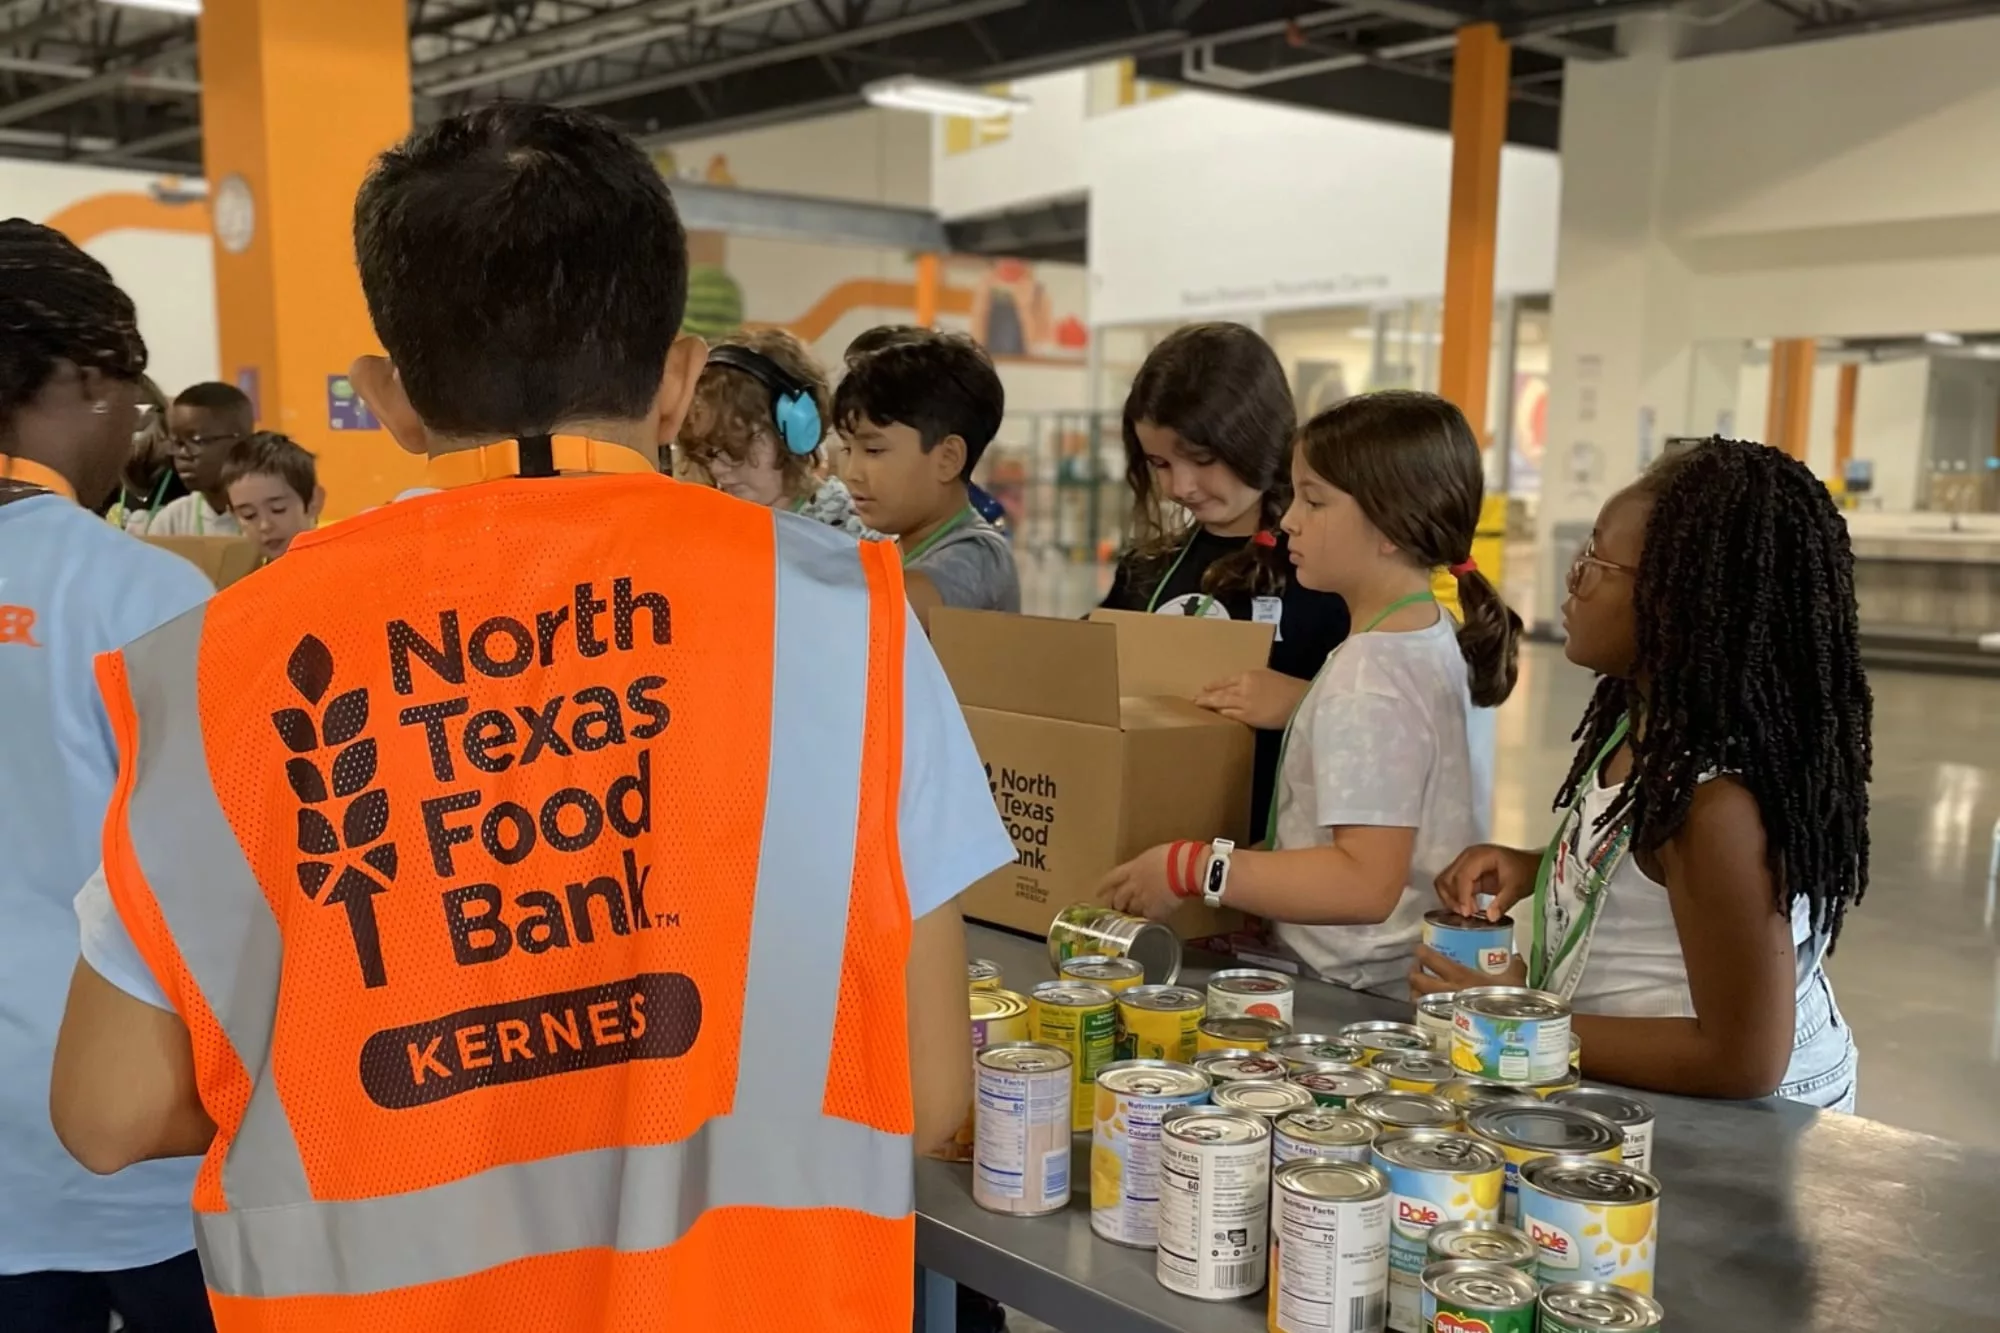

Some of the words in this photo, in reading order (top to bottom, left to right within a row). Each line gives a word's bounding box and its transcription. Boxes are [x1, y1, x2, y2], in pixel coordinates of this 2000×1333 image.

[386, 577, 672, 695] North
[399, 675, 671, 782] Texas
[1001, 767, 1057, 799] North
[421, 749, 650, 877] Food
[1001, 792, 1054, 823] Texas
[1001, 816, 1049, 846] ood
[1012, 847, 1046, 871] ank
[442, 848, 652, 966] Bank
[1128, 1101, 1164, 1110] Nutrition
[1187, 1180, 1199, 1191] 60
[1313, 1206, 1335, 1215] Facts
[1400, 1201, 1438, 1223] Dole
[1323, 1233, 1335, 1242] 70
[1532, 1224, 1568, 1250] Dole
